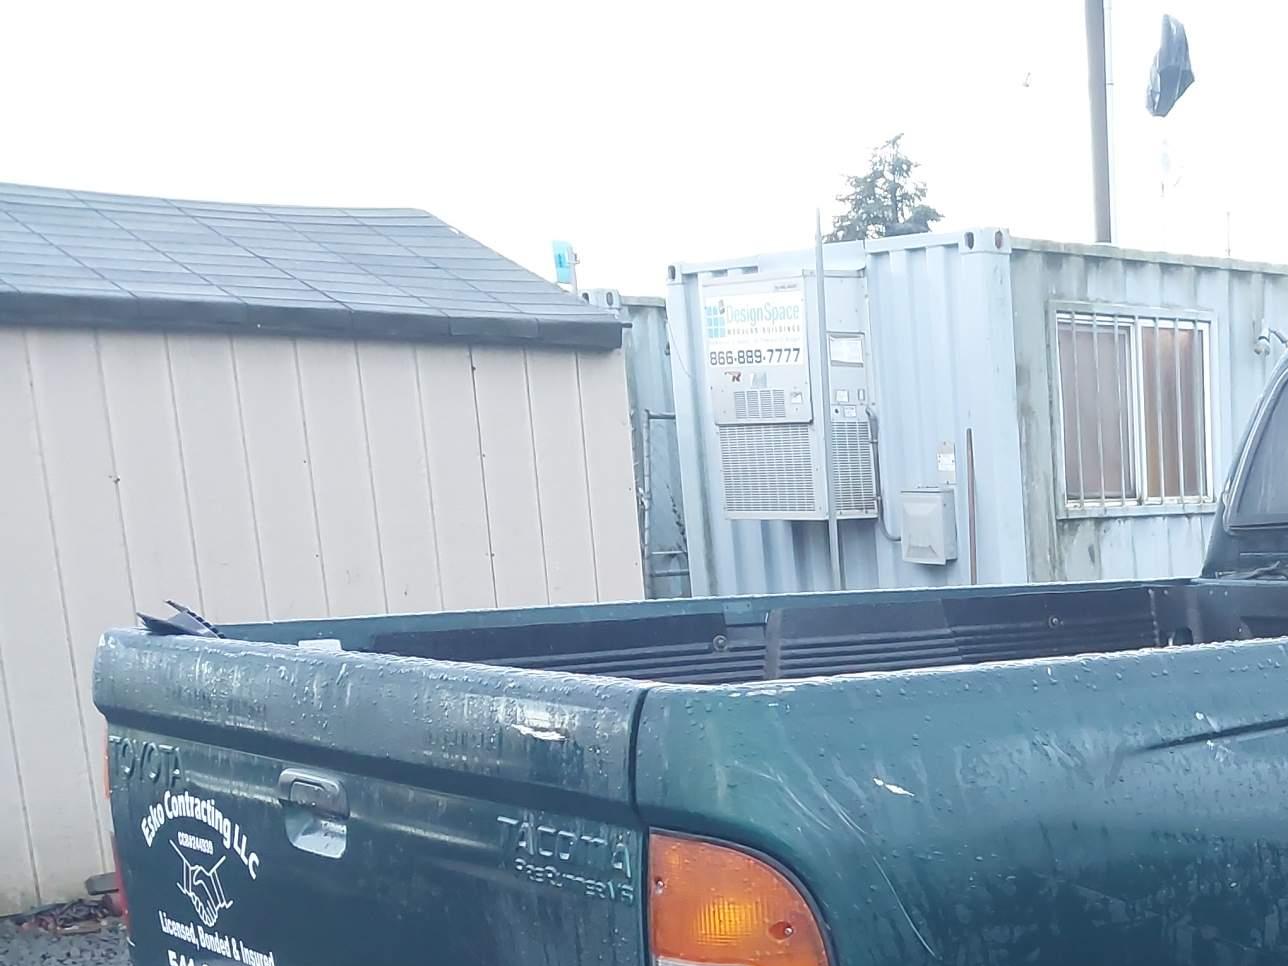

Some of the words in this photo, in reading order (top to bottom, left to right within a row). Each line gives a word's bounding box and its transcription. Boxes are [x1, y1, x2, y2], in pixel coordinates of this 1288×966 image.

[108, 735, 185, 788] TOYOTA
[141, 803, 166, 848] Esko
[164, 790, 231, 849] Contracting
[233, 823, 260, 881] LLC
[497, 815, 633, 879] TACOMA
[158, 910, 200, 951] Licensed,
[197, 925, 232, 959] Bonded
[231, 937, 241, 962] &
